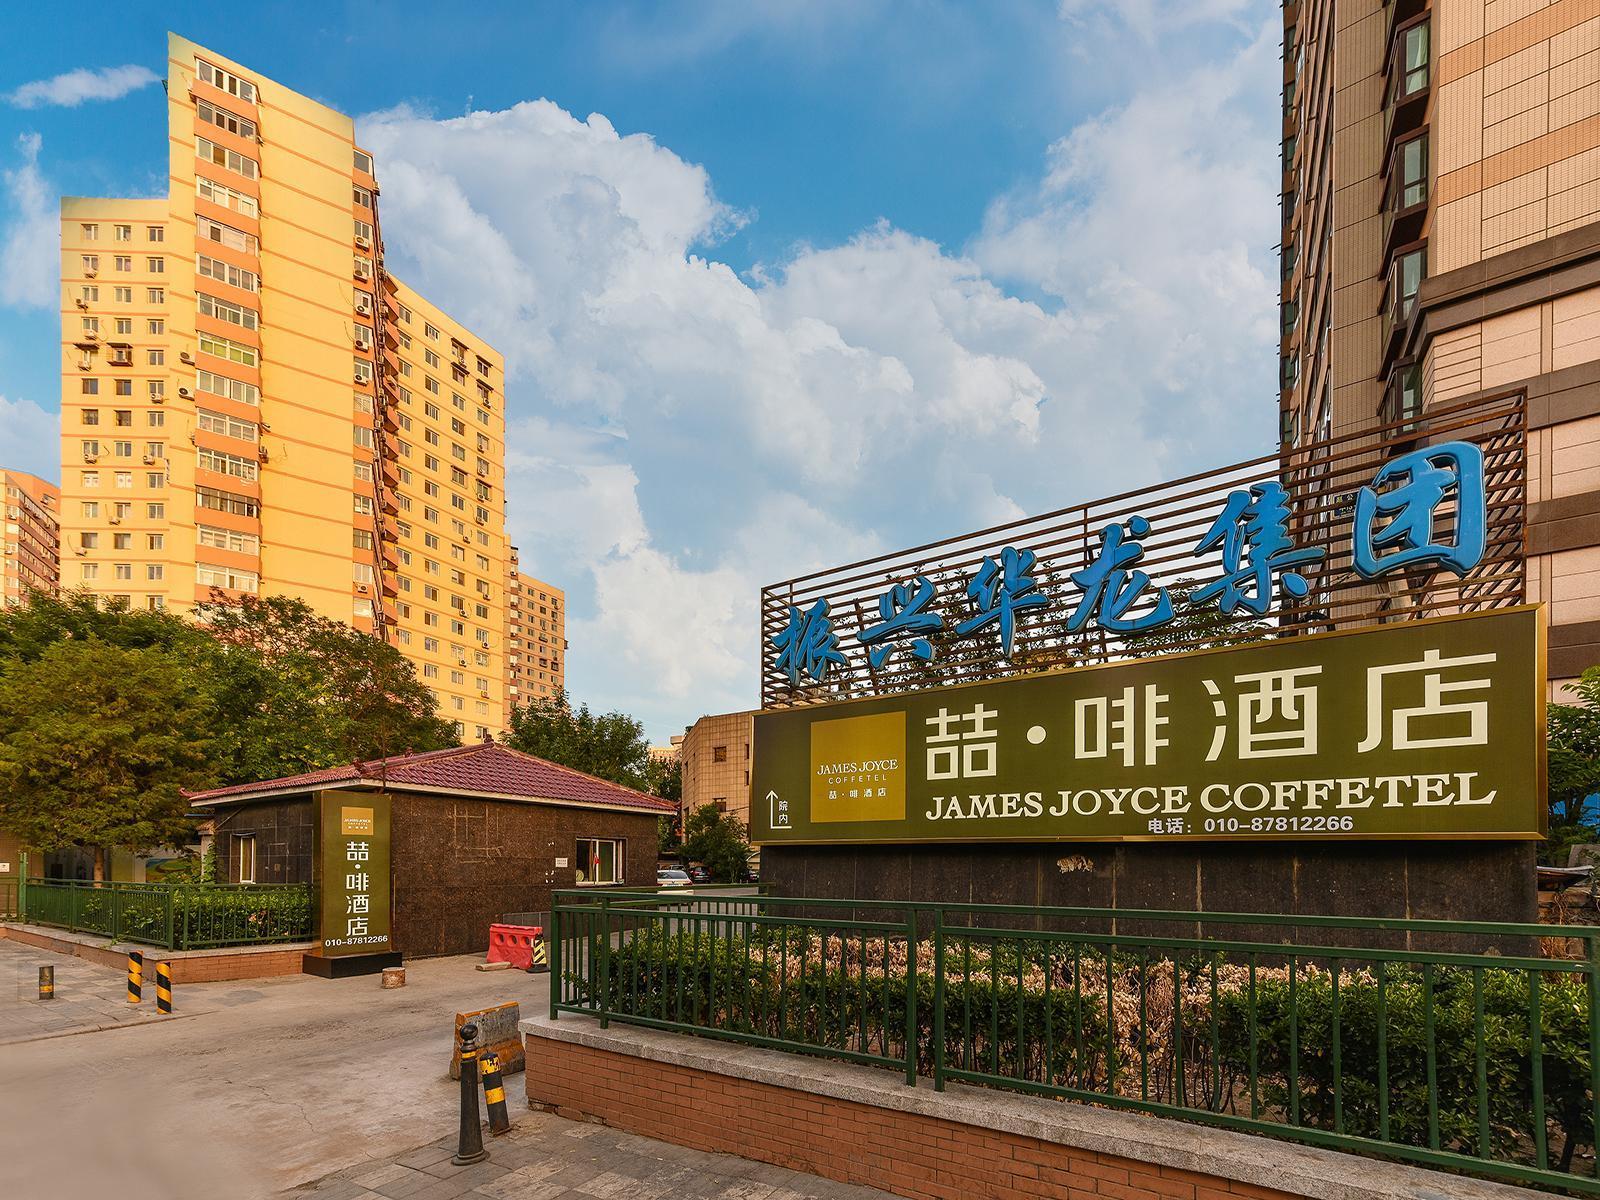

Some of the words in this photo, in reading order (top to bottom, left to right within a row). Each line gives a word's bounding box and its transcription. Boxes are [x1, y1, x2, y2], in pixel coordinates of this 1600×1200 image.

[769, 440, 1487, 687] 振兴华龙集团
[817, 762, 857, 775] JAMES
[858, 759, 898, 772] JOYCE
[828, 774, 887, 785] COFFETEL
[925, 792, 1043, 821] JAMES
[1049, 786, 1191, 818] JOYCE
[1200, 772, 1498, 813] COFFETEL
[778, 800, 789, 824] 院内
[1203, 815, 1354, 833] 010-87812266
[324, 935, 389, 947] 010-87812266
